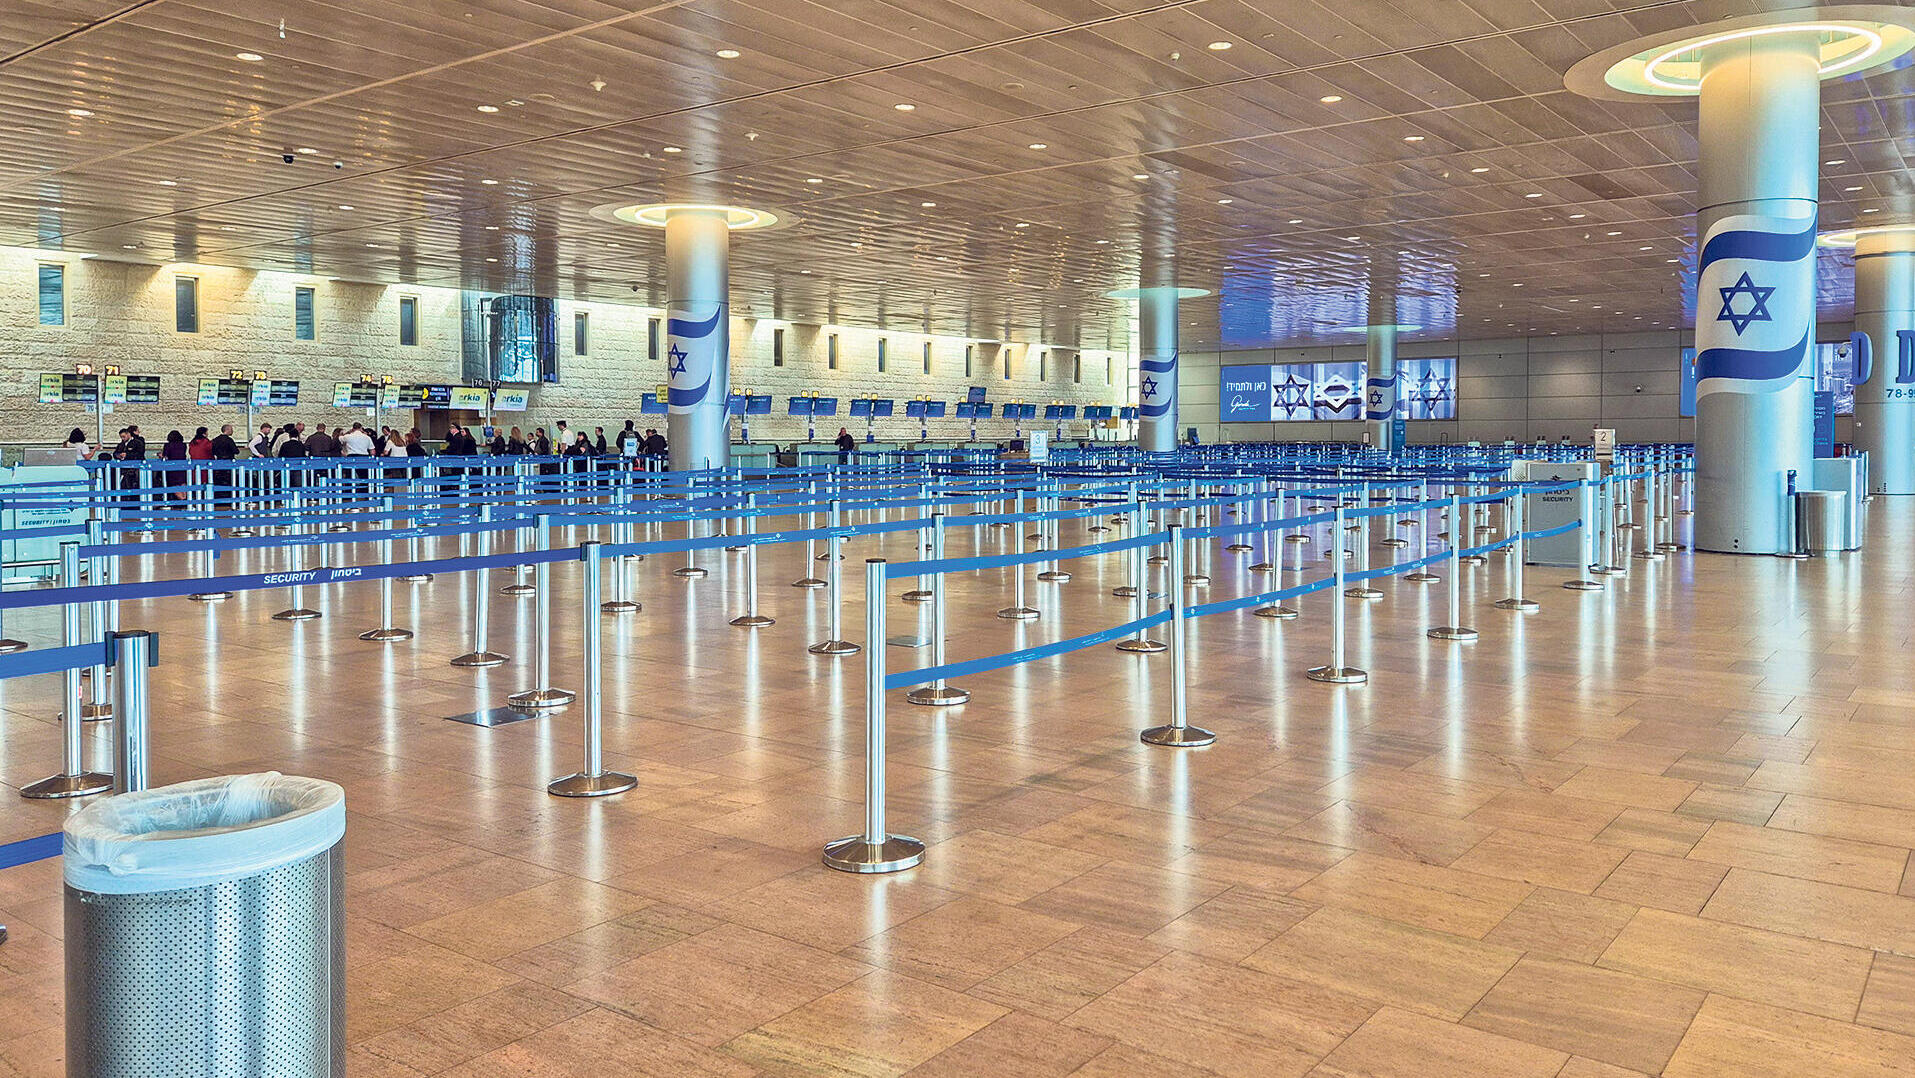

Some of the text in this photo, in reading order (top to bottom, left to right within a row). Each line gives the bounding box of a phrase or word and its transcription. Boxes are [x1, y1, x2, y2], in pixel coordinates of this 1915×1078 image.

[77, 365, 92, 374] 70
[106, 366, 119, 375] 71
[231, 371, 242, 379] 72
[1254, 382, 1266, 392] כאן
[1886, 389, 1915, 399] 78-9
[1600, 431, 1606, 442] 2
[263, 568, 362, 584] SECURITY ביטחון
